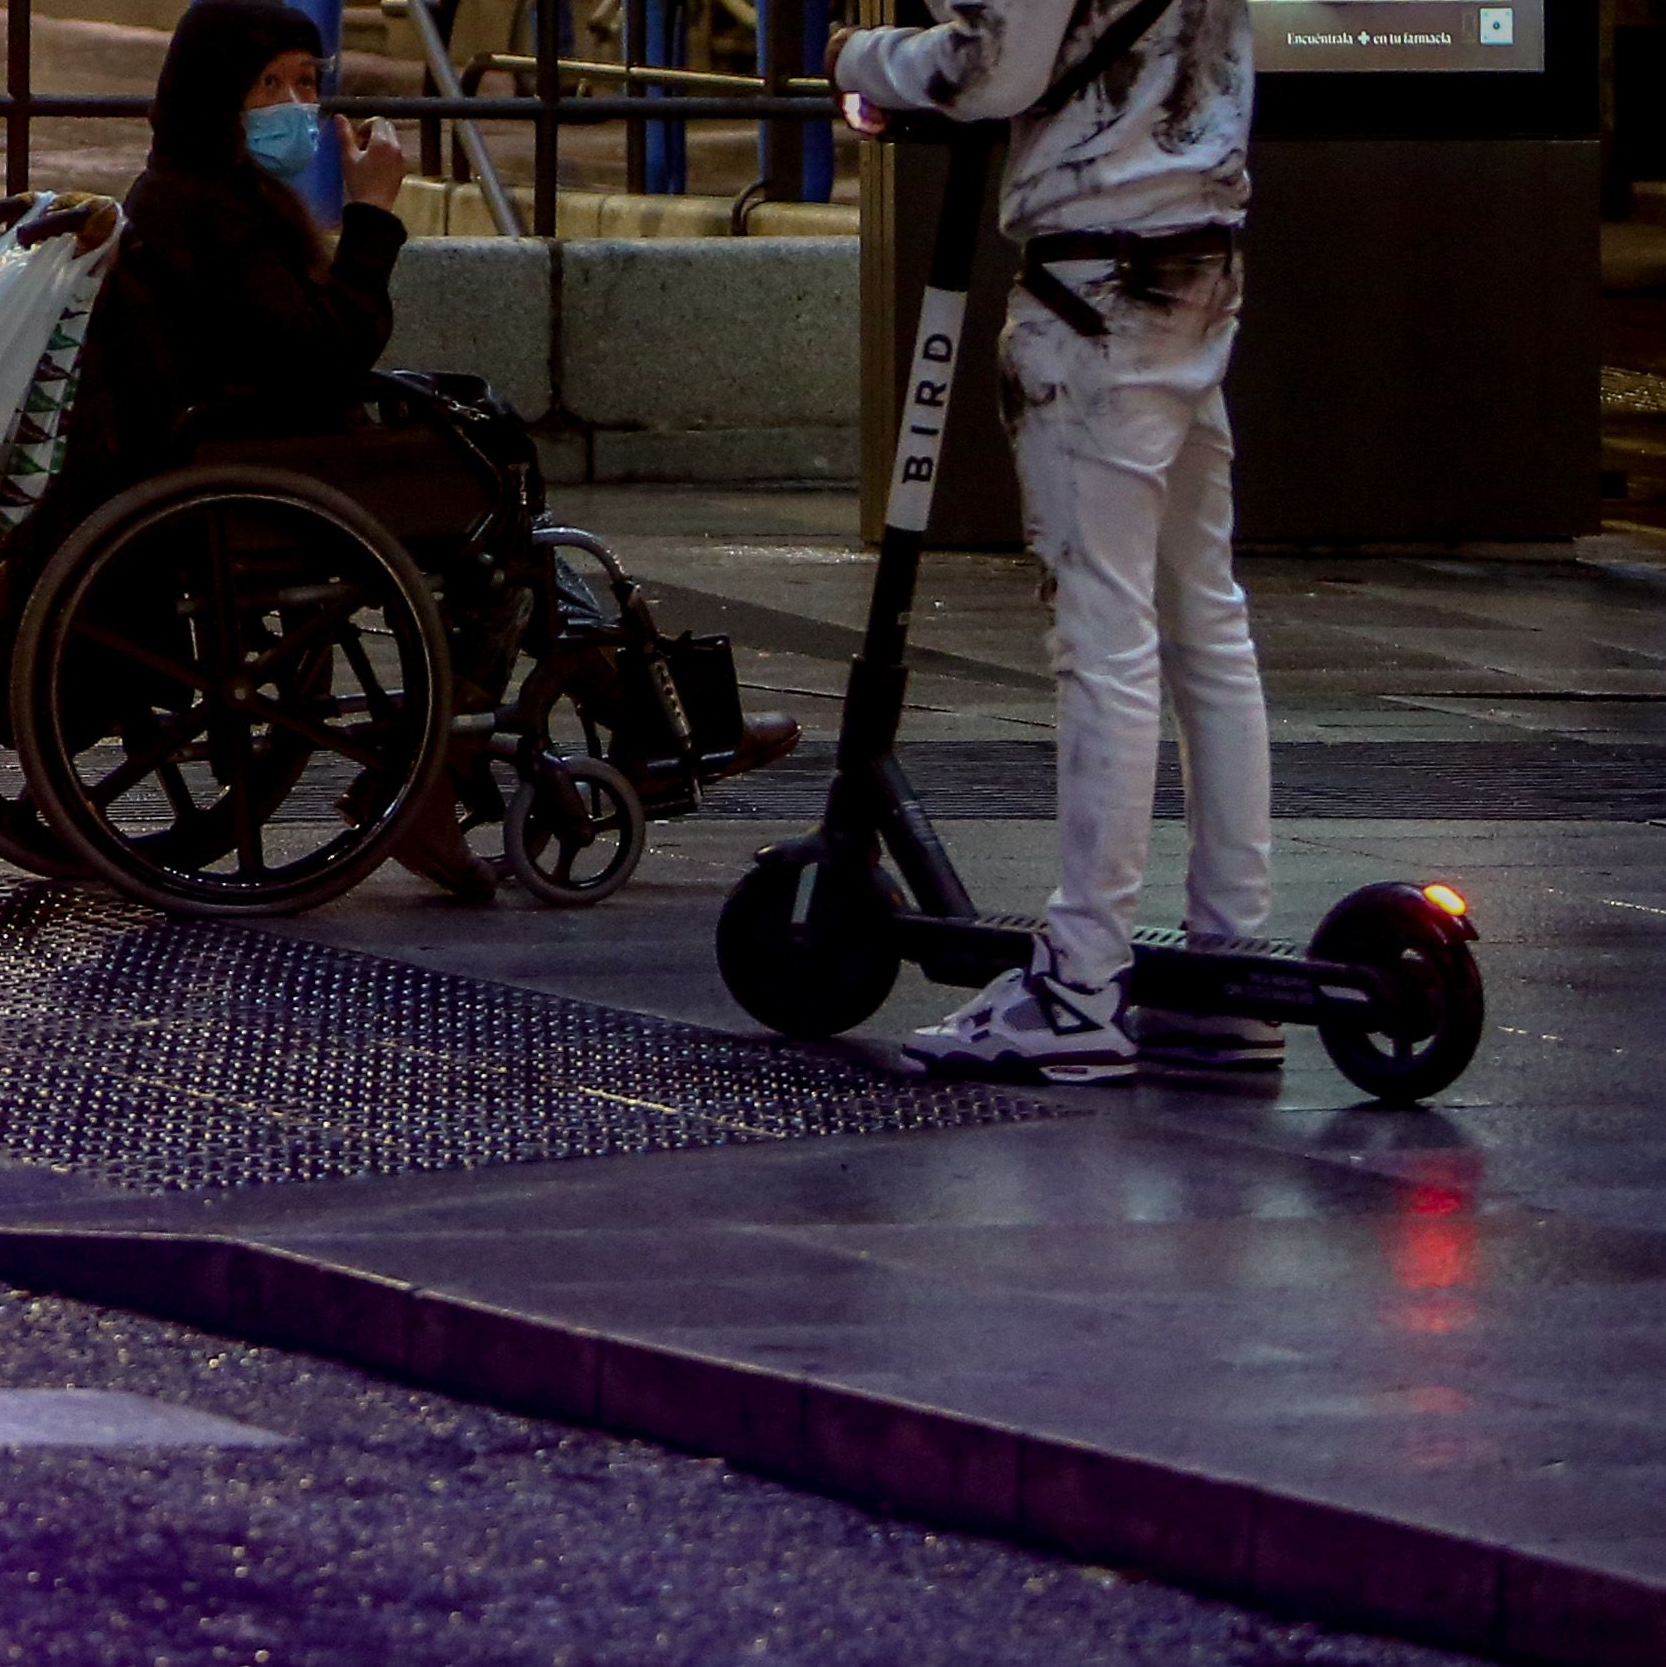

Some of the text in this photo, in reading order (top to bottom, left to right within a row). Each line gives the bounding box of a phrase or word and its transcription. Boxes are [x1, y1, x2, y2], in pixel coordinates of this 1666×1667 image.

[1287, 32, 1354, 46] Encuéntrala
[1373, 36, 1388, 45] en
[1403, 32, 1452, 45] farmacia
[902, 332, 954, 485] BIRD
